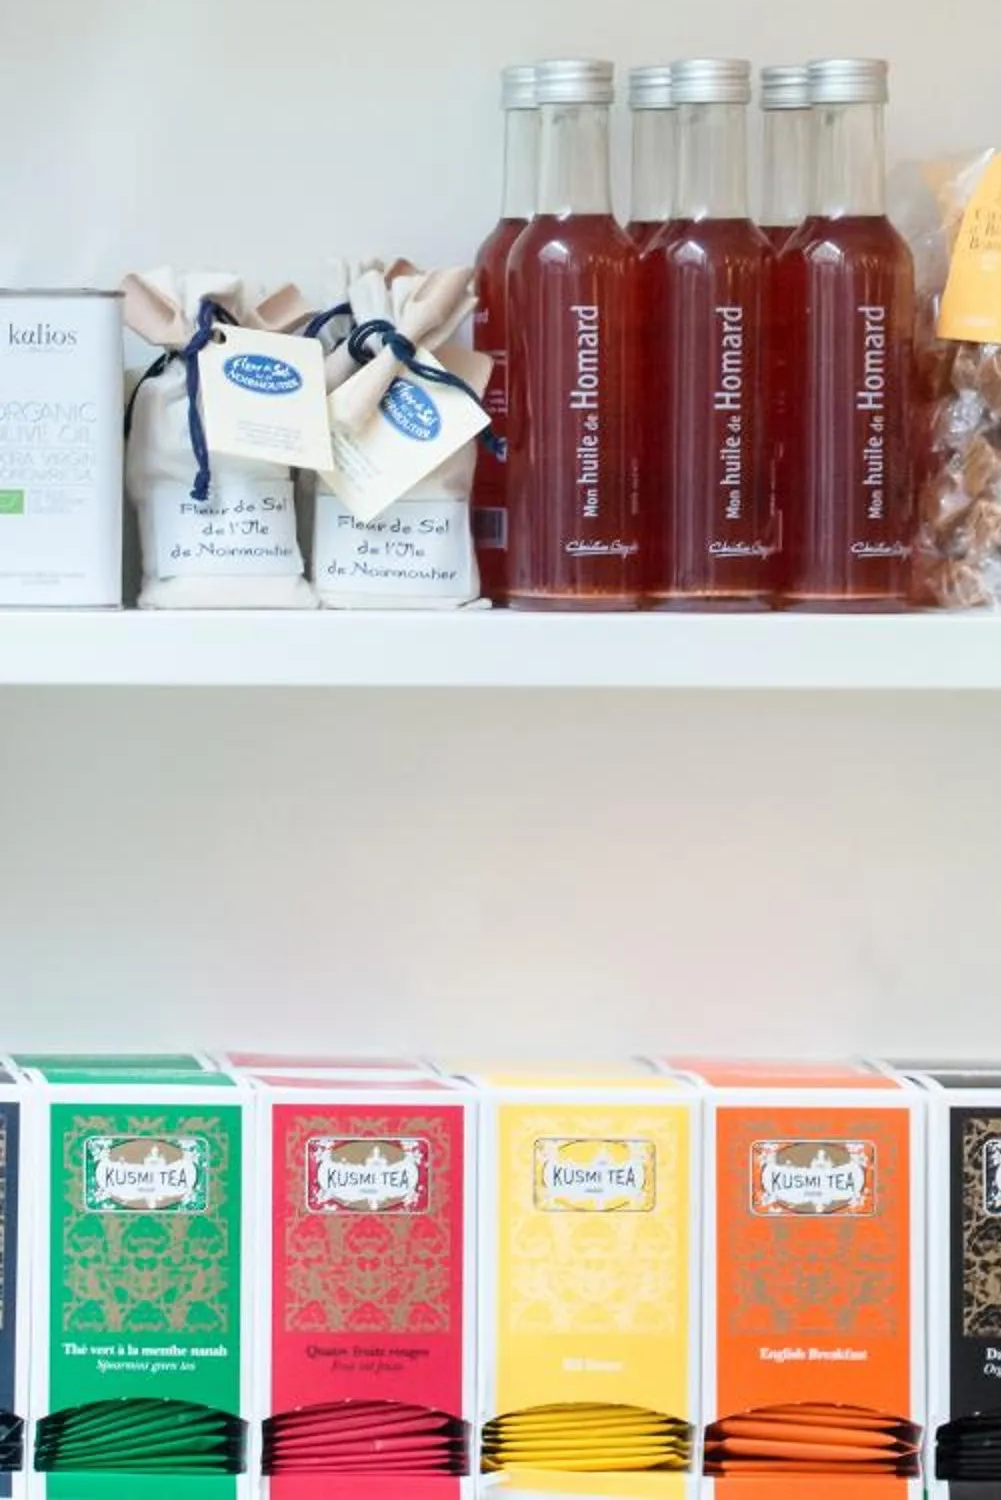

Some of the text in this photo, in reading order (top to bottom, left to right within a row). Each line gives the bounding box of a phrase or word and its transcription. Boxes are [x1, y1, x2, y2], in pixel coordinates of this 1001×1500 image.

[8, 322, 78, 346] kalios
[569, 305, 600, 518] Mon huile de Homard
[714, 305, 743, 518] Mon huile de Homard
[857, 305, 886, 518] Mon huile de Homard
[180, 497, 287, 517] Fleur de Sel
[201, 522, 225, 537] de
[337, 515, 450, 535] Fleur de Sel
[170, 544, 192, 559] de
[357, 540, 380, 555] de
[327, 559, 347, 576] de
[105, 1167, 188, 1189] KUSMI TEA
[327, 1167, 409, 1189] KUSMI TEA
[552, 1165, 636, 1189] KUSMI TEA
[770, 1170, 855, 1192] KUSMI TEA
[90, 1344, 115, 1356] vert
[126, 1343, 139, 1356] la
[141, 1343, 187, 1357] menthe
[190, 1343, 228, 1357] nanah
[808, 1347, 868, 1361] Breakfast
[150, 1361, 177, 1373] green
